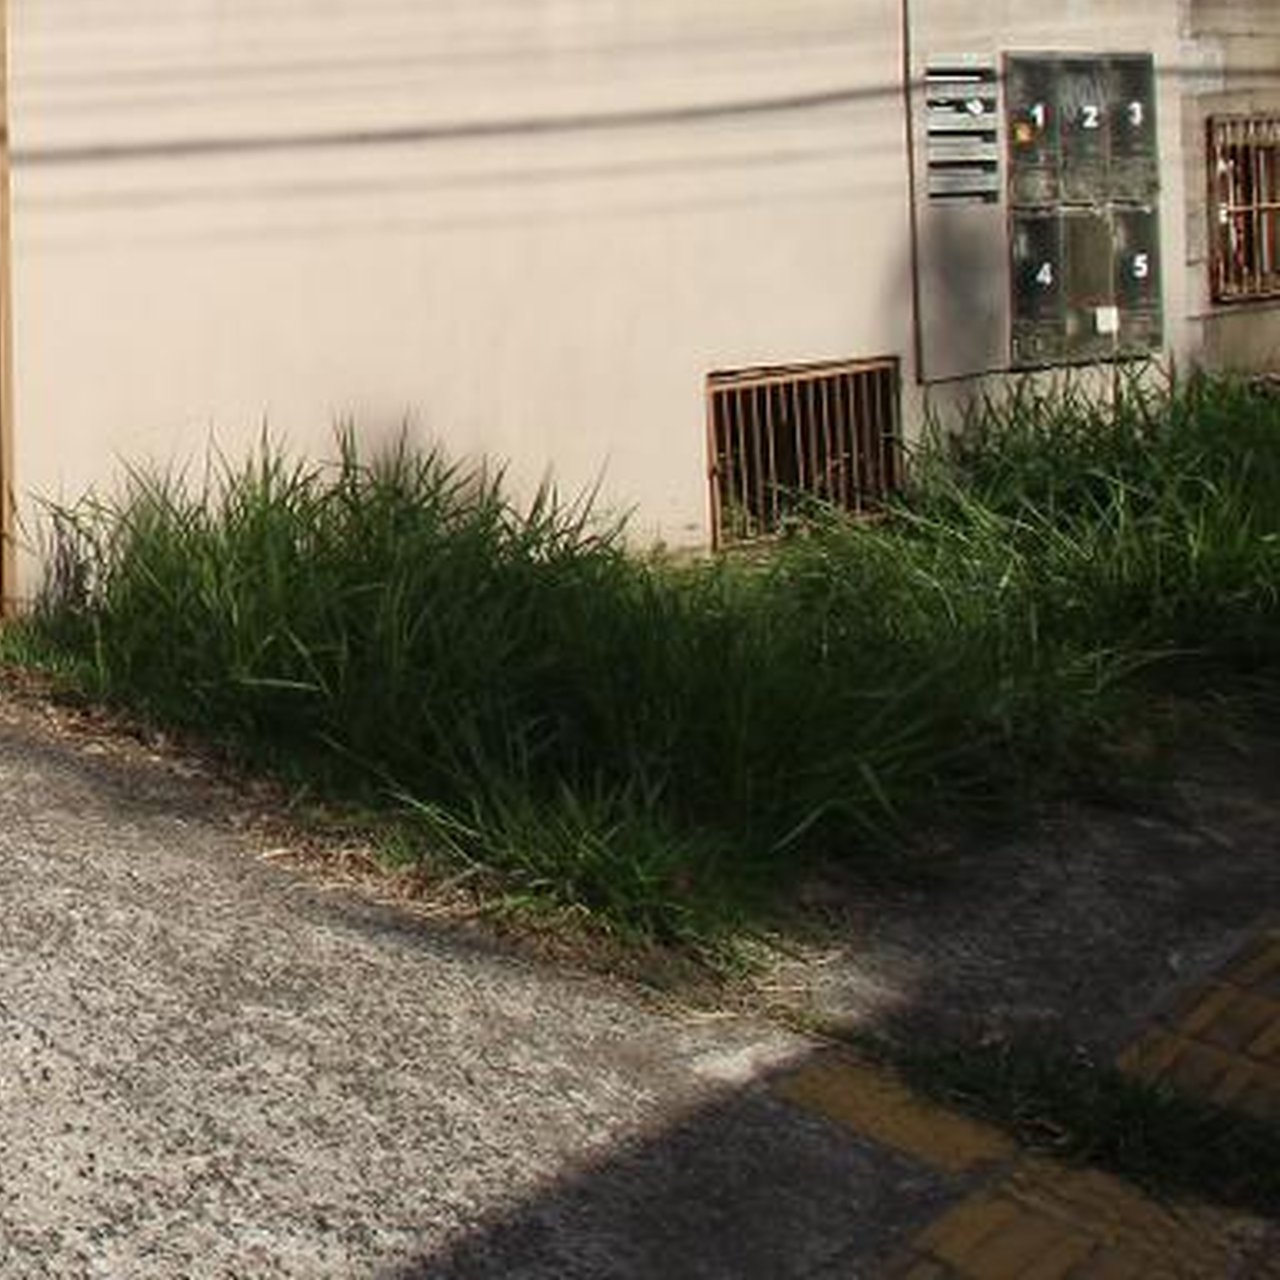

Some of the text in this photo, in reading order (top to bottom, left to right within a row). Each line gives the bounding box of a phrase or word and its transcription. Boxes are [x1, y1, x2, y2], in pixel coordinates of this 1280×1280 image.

[1030, 104, 1045, 126] 1
[1082, 105, 1099, 128] 2
[1036, 262, 1052, 284] 4
[1133, 254, 1148, 277] 5
